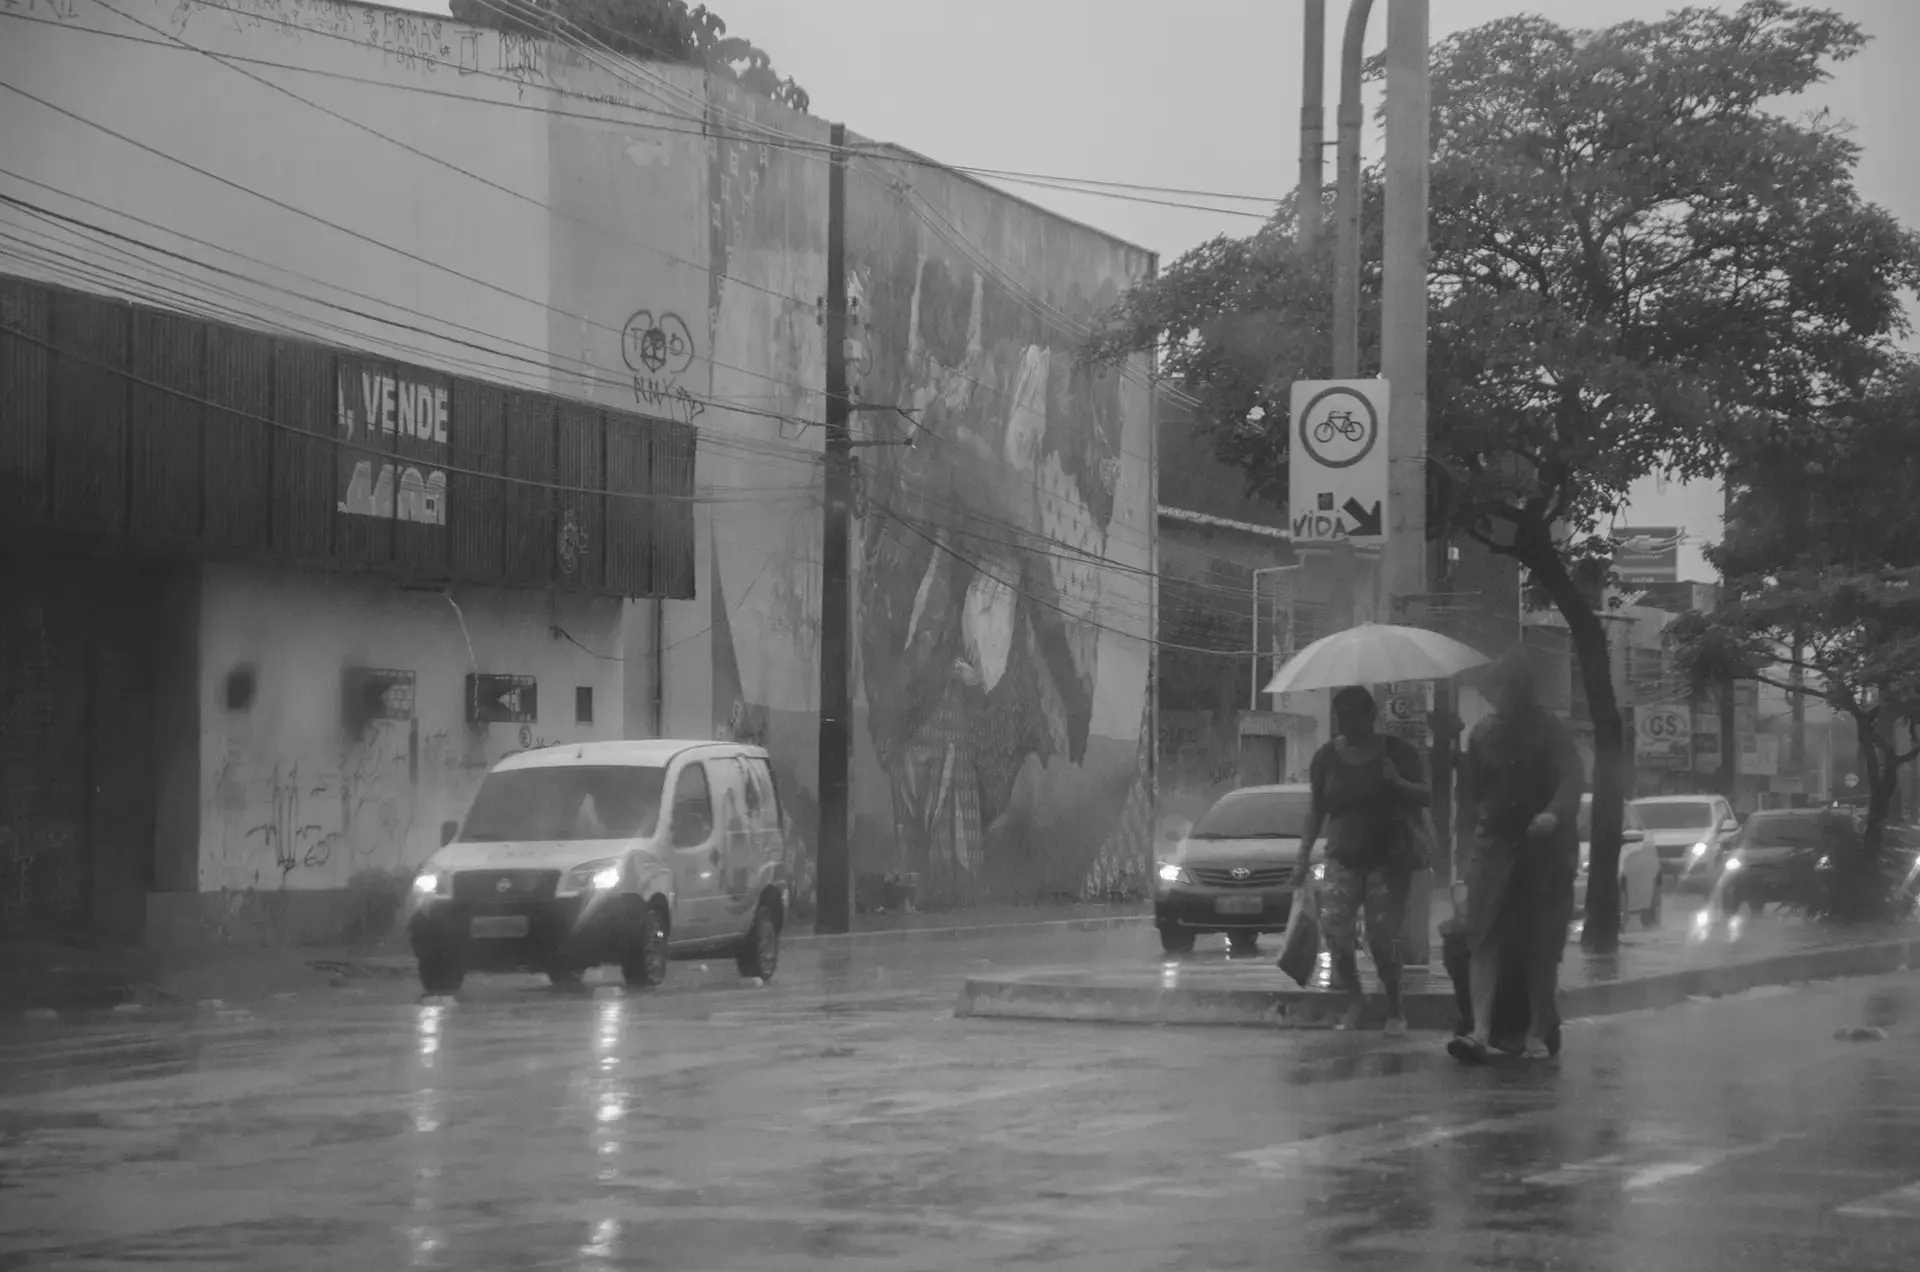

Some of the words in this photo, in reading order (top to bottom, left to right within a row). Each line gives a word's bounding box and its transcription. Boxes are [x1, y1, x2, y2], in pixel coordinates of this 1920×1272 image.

[361, 370, 449, 444] VENDE
[1293, 514, 1347, 539] VIDA
[1649, 714, 1678, 737] GS
